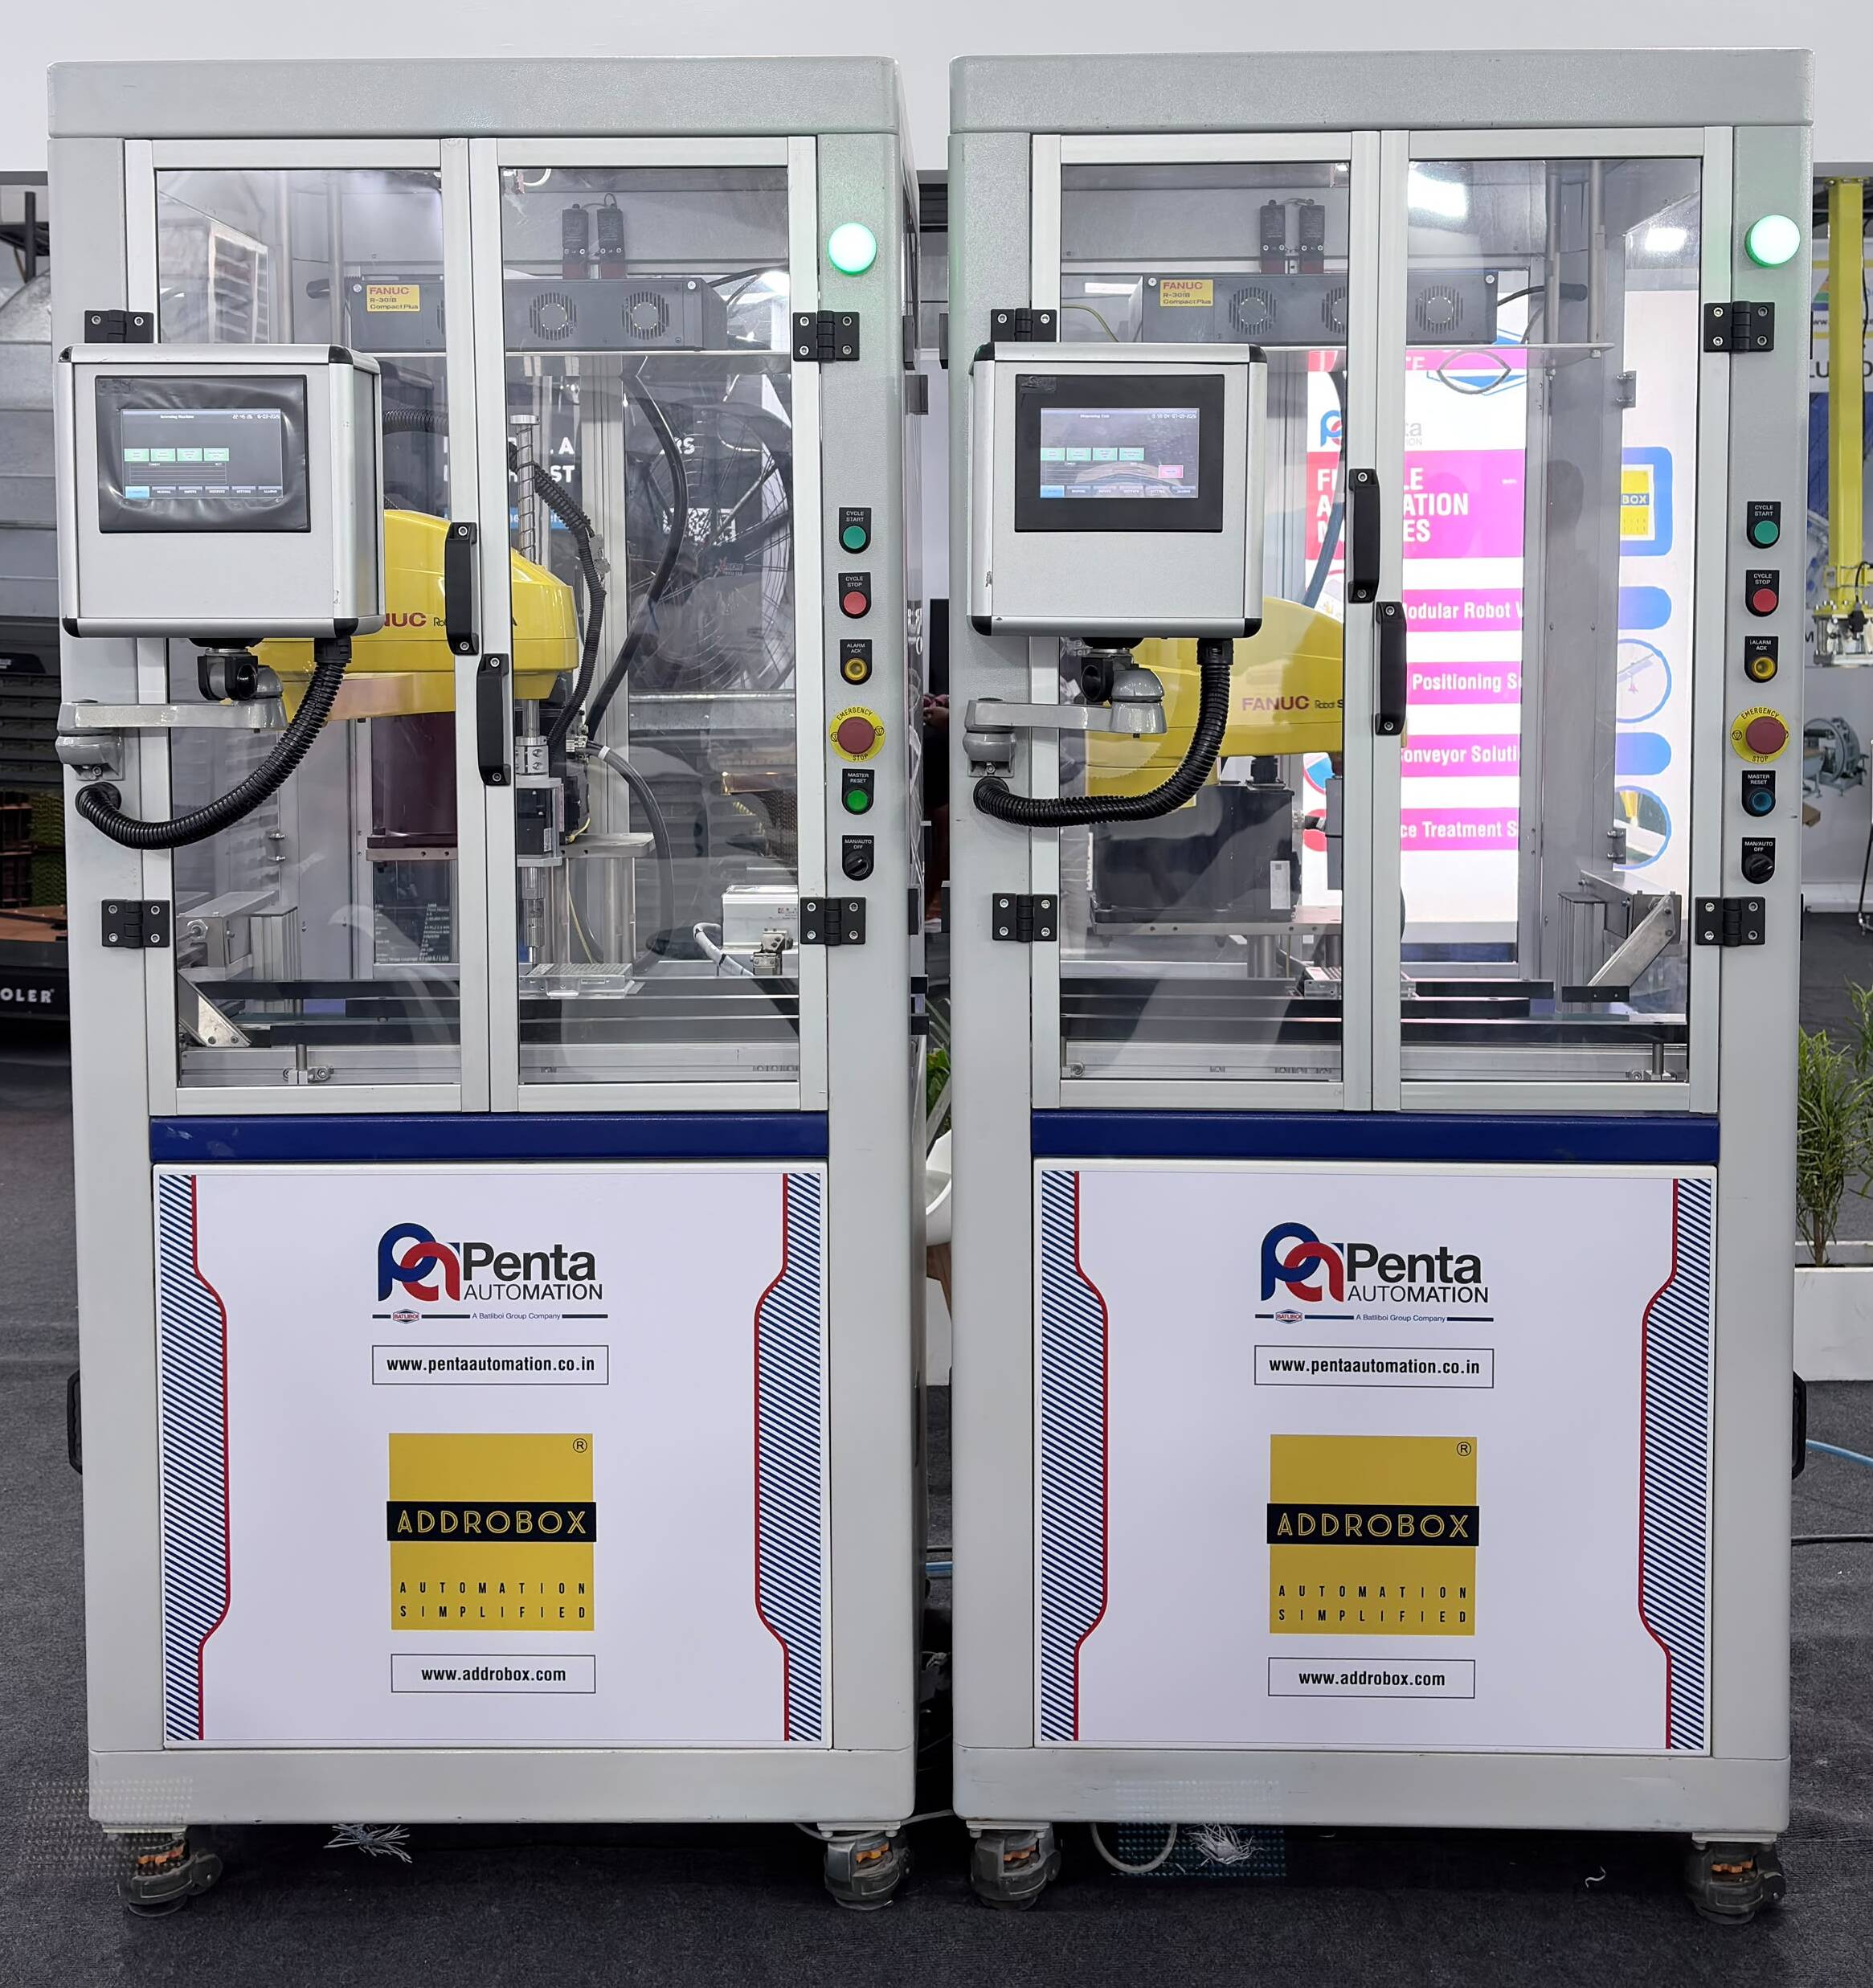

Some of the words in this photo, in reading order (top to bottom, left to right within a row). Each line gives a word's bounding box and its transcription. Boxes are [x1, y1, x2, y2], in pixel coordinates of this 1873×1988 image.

[370, 287, 409, 295] FANUC
[1163, 282, 1203, 290] FANUC
[1403, 602, 1459, 620] odular
[1464, 601, 1511, 620] Robot
[1412, 673, 1502, 693] Positioning
[1241, 696, 1310, 711] FANUC
[836, 706, 873, 721] EMERGENCY
[1740, 706, 1780, 720] EMERGENCY
[852, 753, 869, 761] STOP
[1401, 747, 1466, 767] onveyor
[1471, 745, 1518, 763] Soluti
[1421, 821, 1503, 838] Treatment
[0, 988, 51, 1003] OLER
[463, 1241, 596, 1282] Penta
[1347, 1242, 1482, 1284] Penta
[464, 1283, 603, 1300] AUTOMATION
[1347, 1285, 1489, 1303] AUTOMATION
[505, 1313, 527, 1321] Group
[529, 1313, 561, 1321] Company
[1390, 1315, 1412, 1323] Group
[1413, 1315, 1446, 1323] Company
[386, 1356, 595, 1374] www.pentaautomation.co.in
[1269, 1358, 1480, 1375] www.pentaautomation.co.in
[397, 1510, 587, 1534] ADDROBOX
[1277, 1512, 1469, 1538] ADDROBOX
[399, 1581, 585, 1594] AUTOMATION
[1278, 1585, 1466, 1599] AUTOMATION
[400, 1605, 586, 1618] SIMPLIFIED
[1278, 1609, 1466, 1623] SIMPLIFIED
[421, 1667, 566, 1681] www.addrobox.com
[1298, 1671, 1446, 1687] www.addrobox.com
